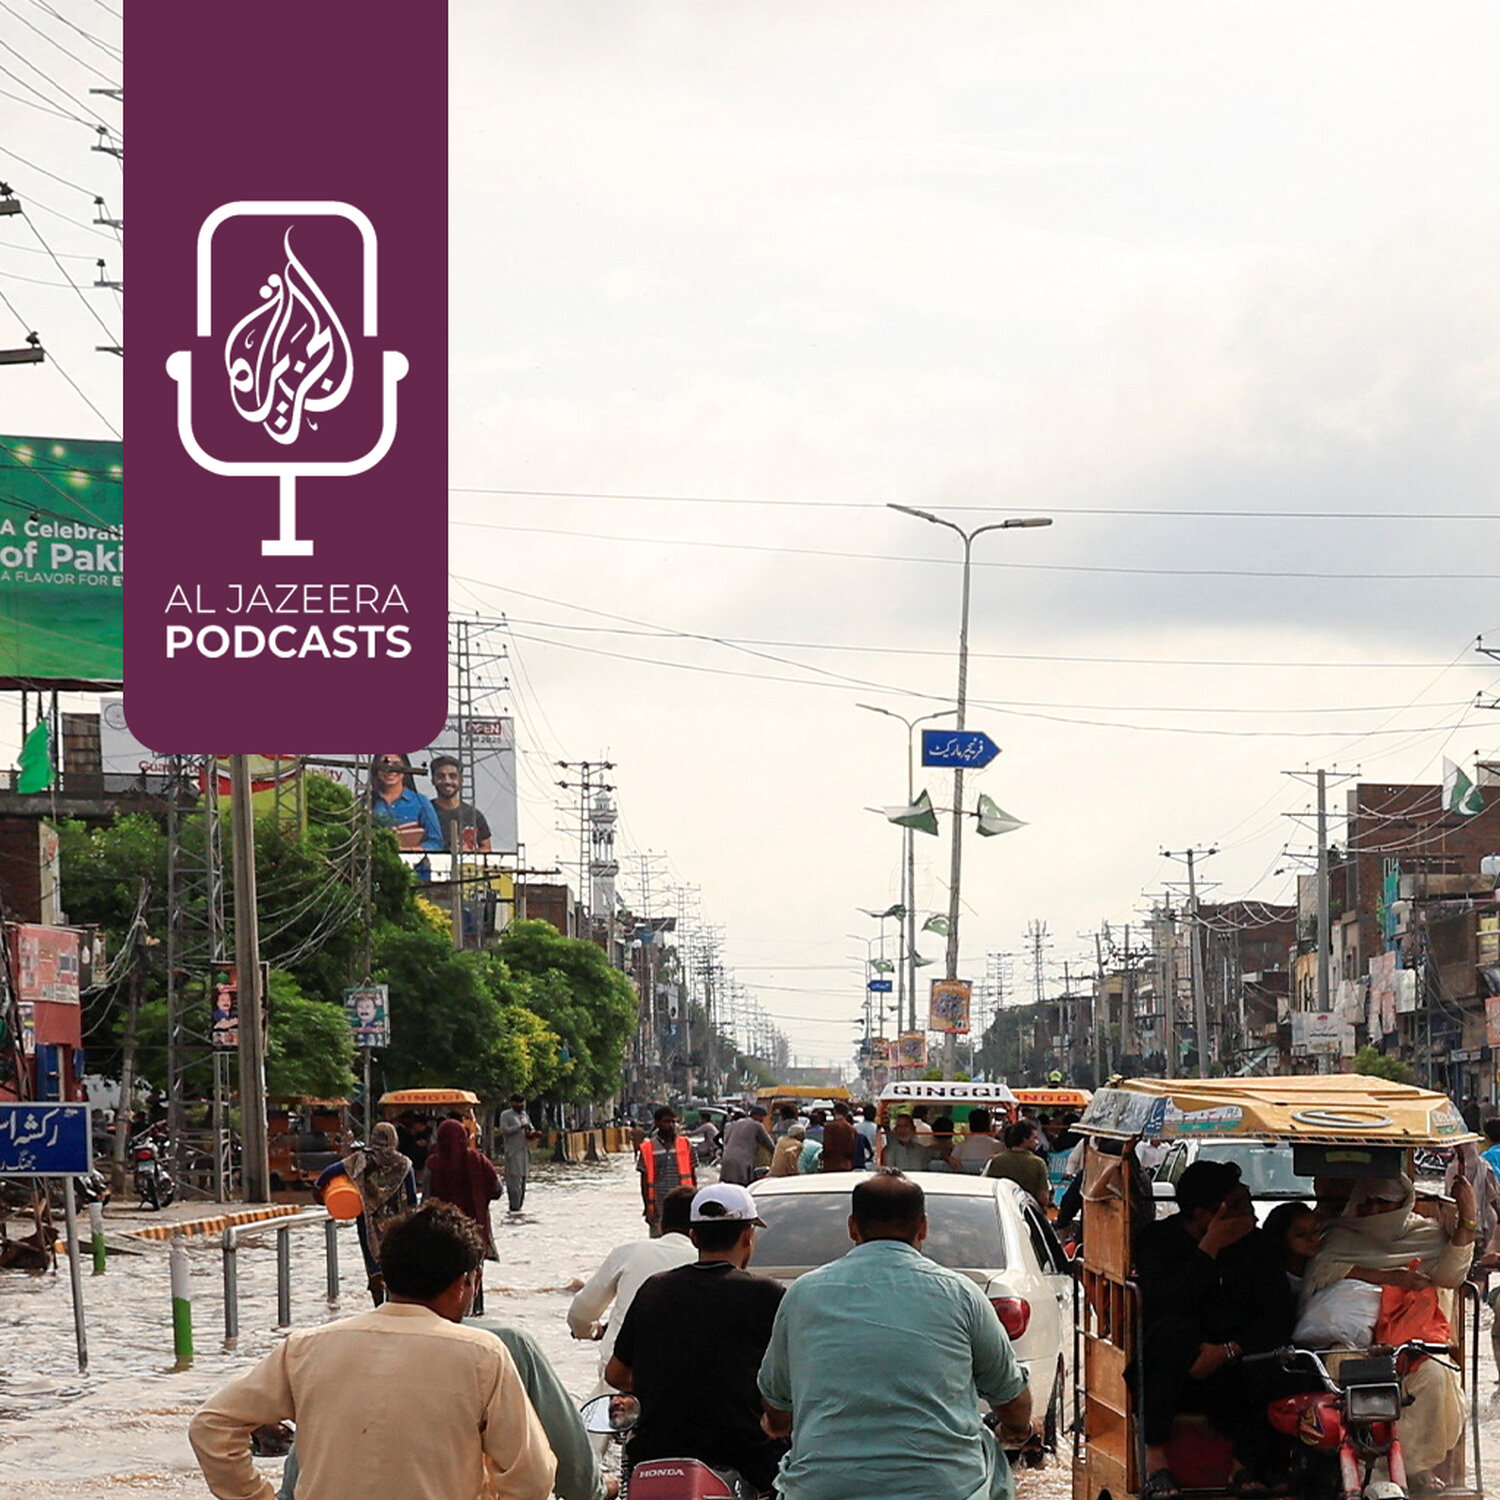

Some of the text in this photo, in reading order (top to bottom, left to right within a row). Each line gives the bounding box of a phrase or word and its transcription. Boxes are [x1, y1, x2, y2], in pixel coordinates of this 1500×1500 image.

[0, 519, 16, 536] A
[0, 540, 38, 568] of
[15, 571, 75, 585] FLAVOR
[79, 574, 108, 586] FOR
[893, 1084, 1001, 1098] QINGQI
[1016, 1093, 1078, 1103] INGQI
[639, 1468, 685, 1478] HONDA
